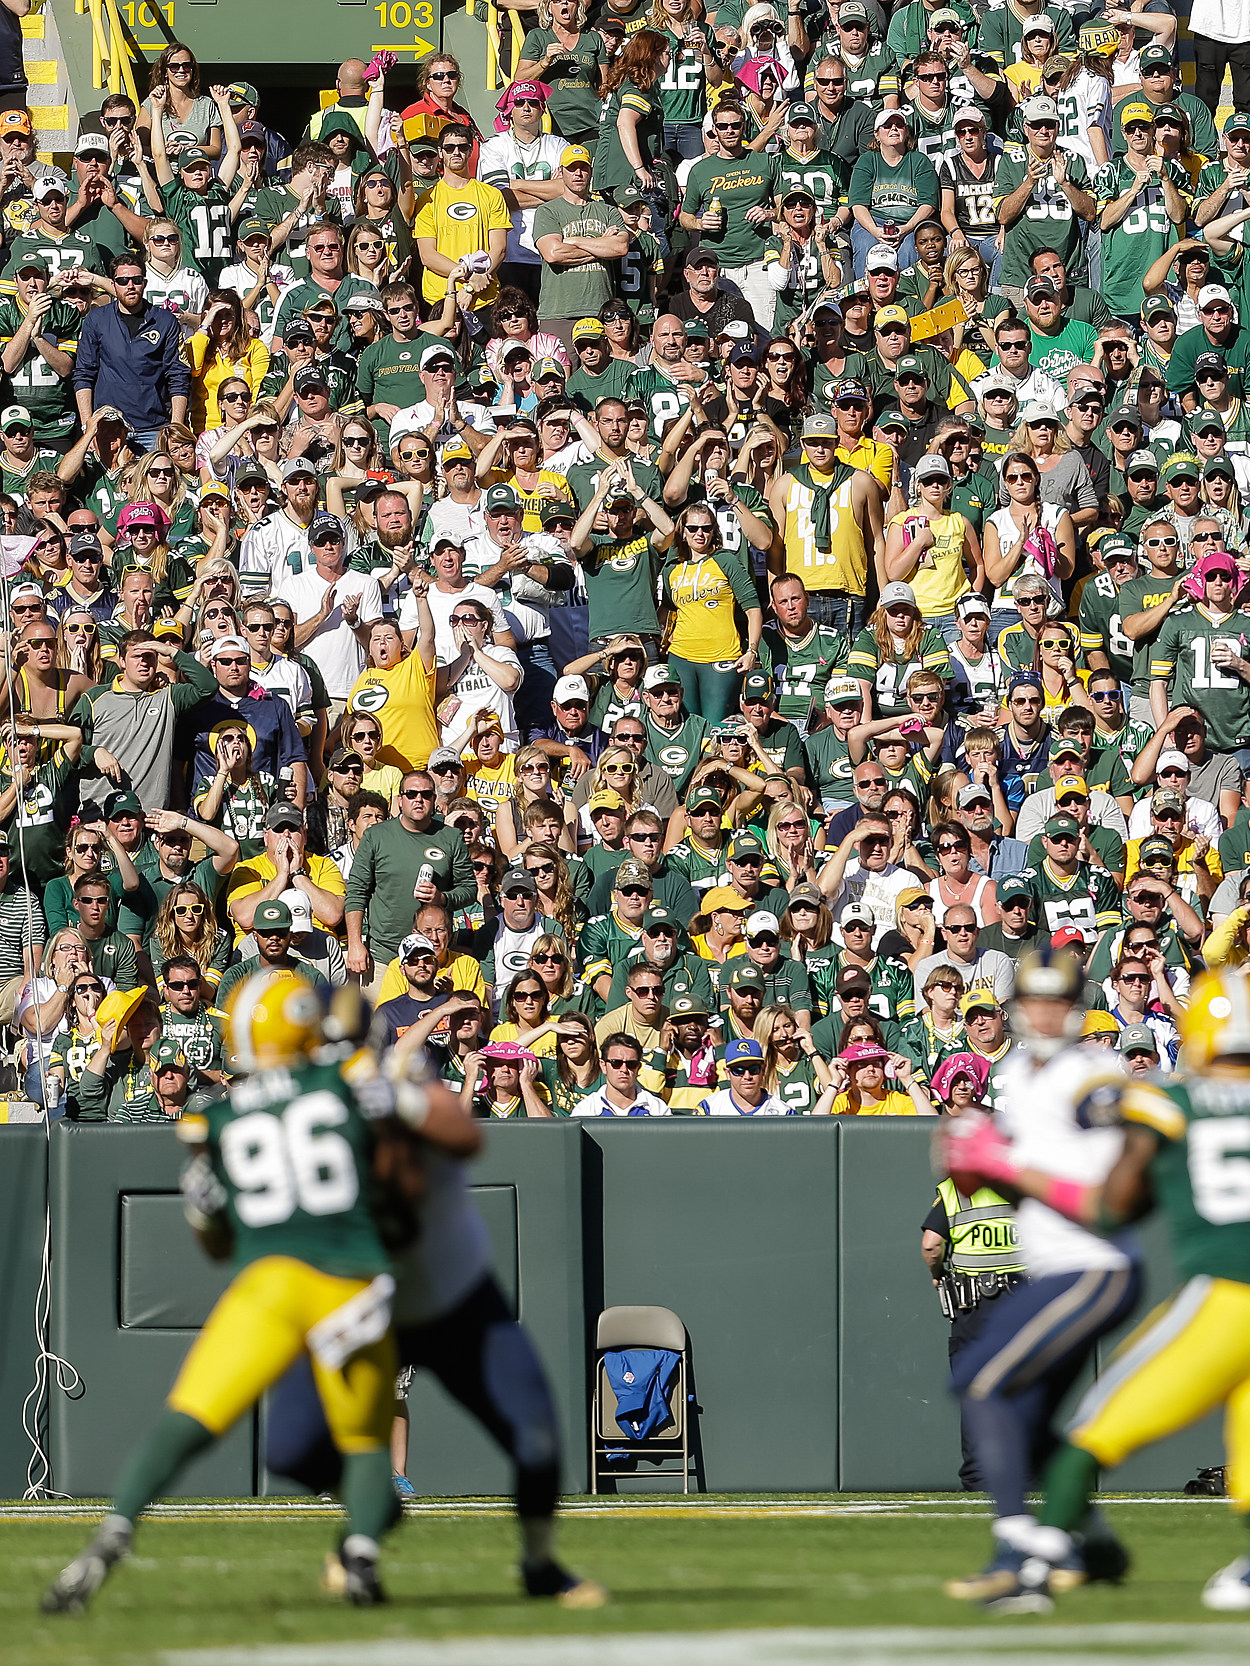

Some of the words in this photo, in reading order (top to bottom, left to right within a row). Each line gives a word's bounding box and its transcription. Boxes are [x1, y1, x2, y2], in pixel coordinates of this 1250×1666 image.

[122, 1, 175, 26] 101
[375, 2, 434, 28] 103
[625, 17, 647, 34] KERS
[1096, 30, 1116, 45] BAY
[659, 49, 704, 90] 12
[710, 175, 764, 194] Packers
[958, 184, 998, 196] PACKER
[447, 202, 477, 221] G
[966, 196, 995, 225] 12
[190, 206, 230, 258] 12
[378, 364, 419, 377] FOOTBA
[981, 441, 1010, 455] PACK
[1191, 636, 1243, 690] 12
[353, 685, 389, 712] G
[659, 746, 689, 766] G
[498, 777, 518, 798] BA
[423, 847, 446, 861] G
[976, 975, 995, 992] BAY
[219, 1091, 360, 1229] 96
